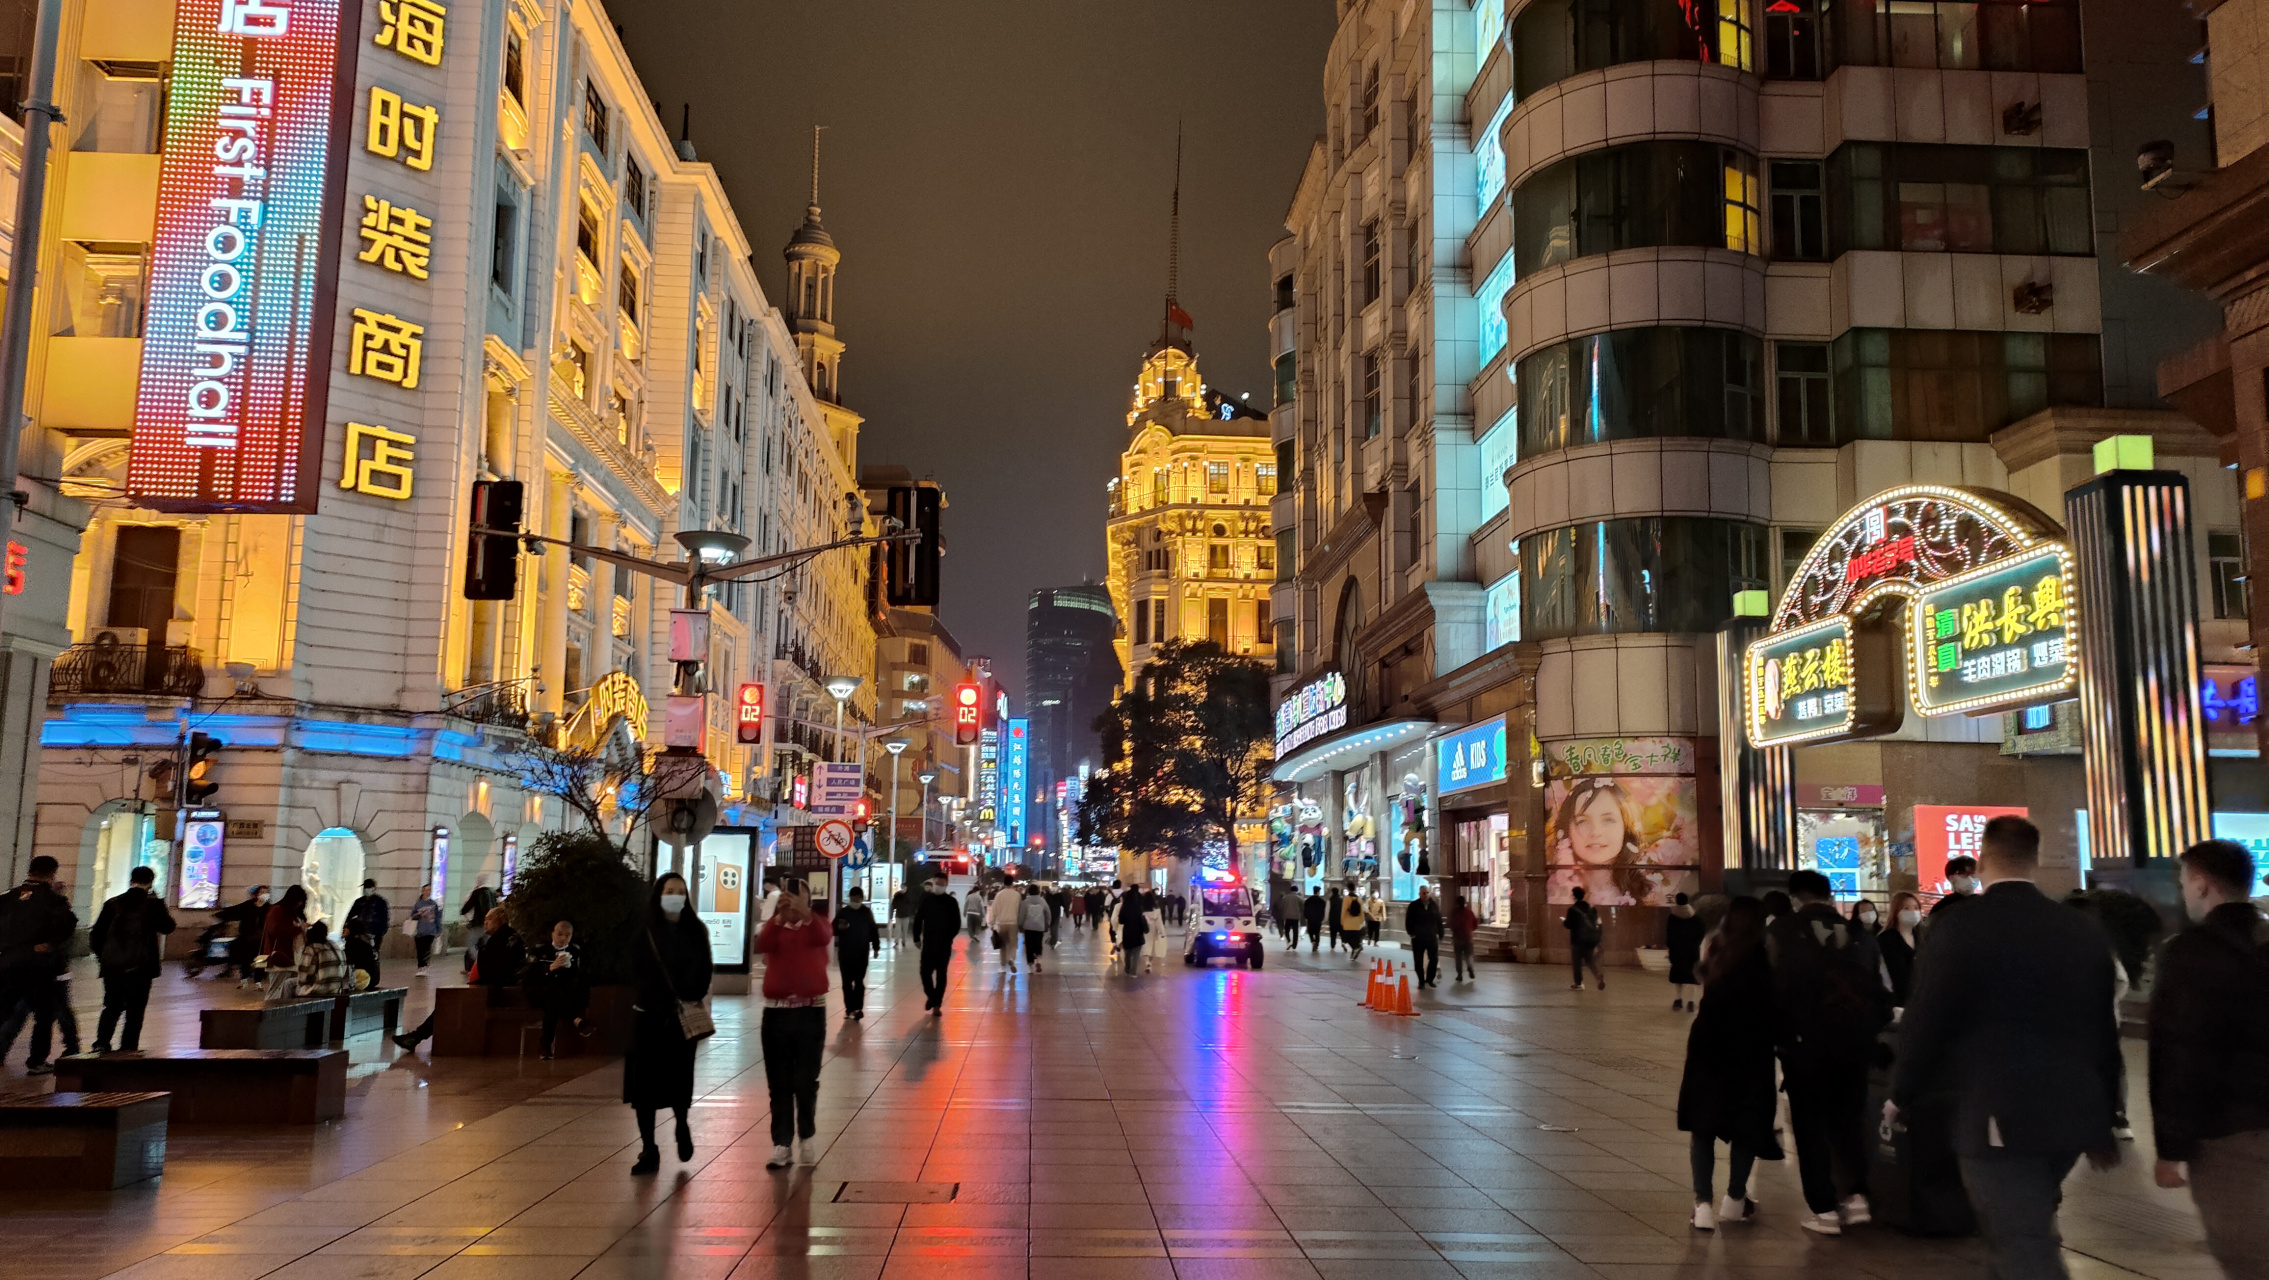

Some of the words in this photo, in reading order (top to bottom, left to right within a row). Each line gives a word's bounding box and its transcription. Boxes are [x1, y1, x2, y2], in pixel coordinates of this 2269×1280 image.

[214, 78, 275, 183] First
[340, 0, 447, 500] 海时装商店
[185, 199, 264, 449] Foodhall
[1846, 535, 1915, 582] 中华老字号
[1935, 608, 1957, 672] 清真
[1961, 649, 2022, 683] 羊肉涮锅
[599, 671, 650, 741] 时装商店
[741, 704, 760, 722] 02
[958, 706, 977, 723] 02
[1328, 704, 1348, 731] KIDS
[1451, 767, 1468, 781] adidas
[1470, 740, 1487, 770] KIDS
